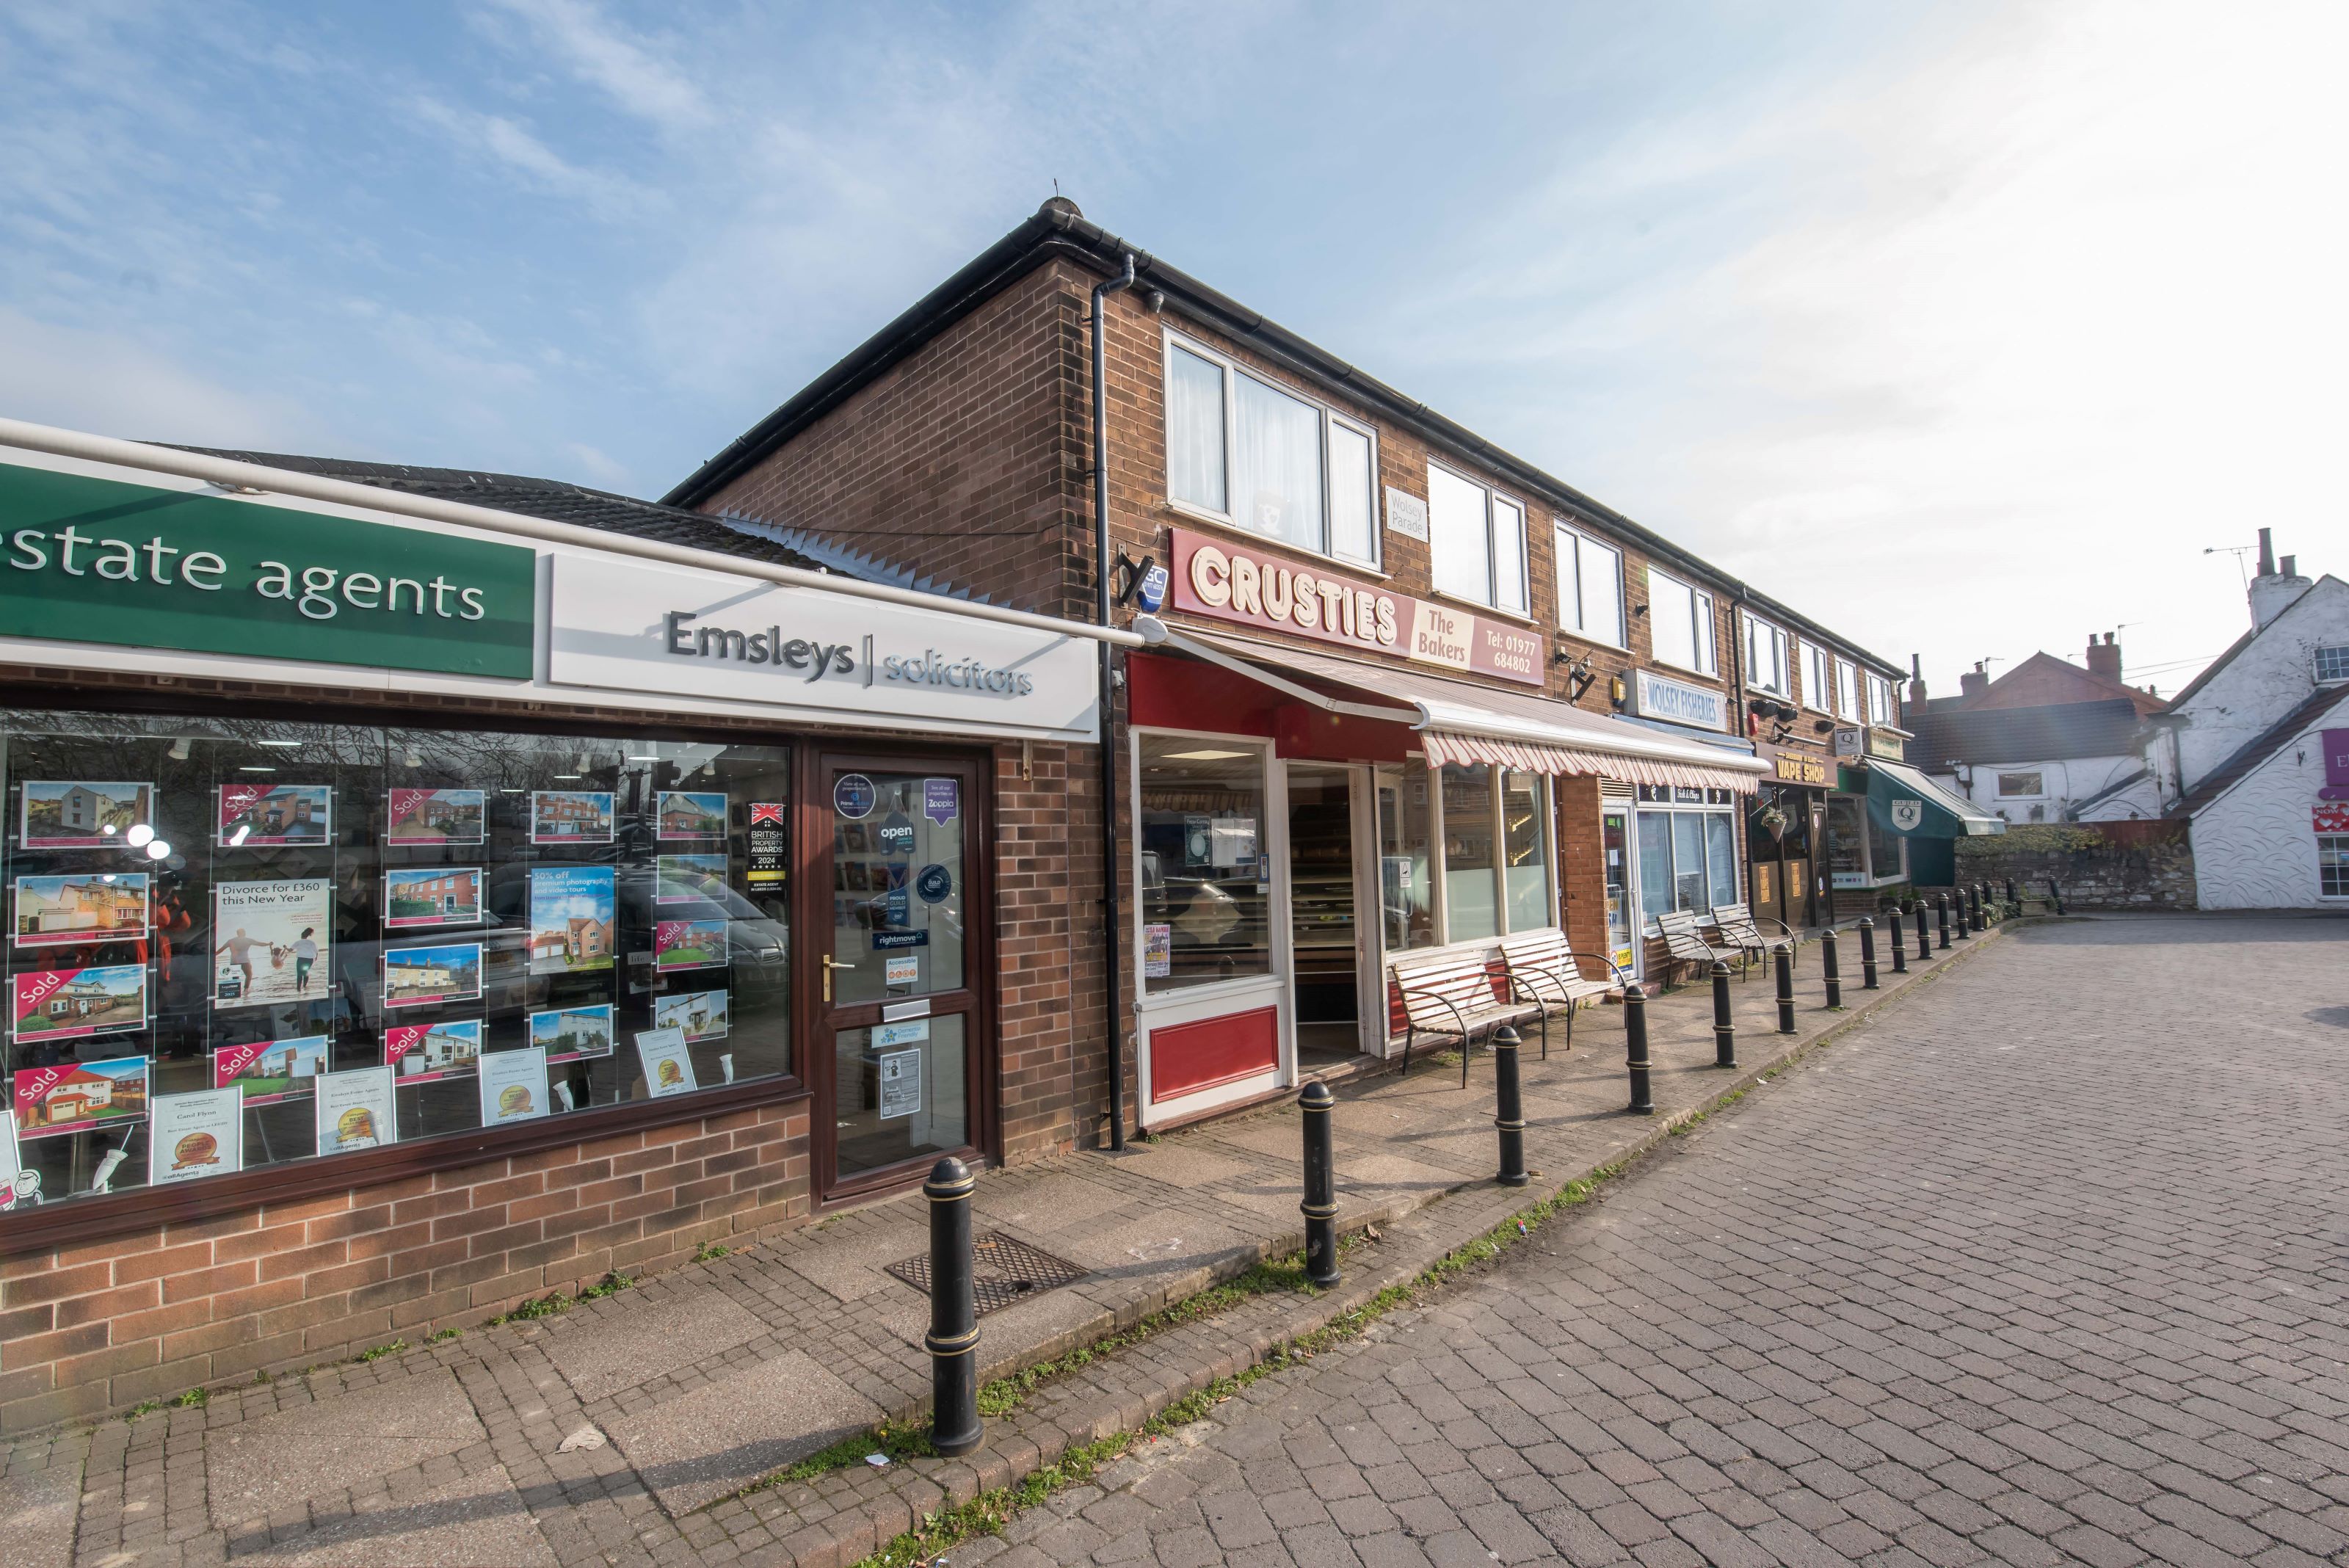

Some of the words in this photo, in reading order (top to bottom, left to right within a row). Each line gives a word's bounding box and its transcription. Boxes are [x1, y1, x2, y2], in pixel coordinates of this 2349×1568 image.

[1391, 495, 1422, 521] Wolsey
[1393, 511, 1423, 534] Parade
[0, 526, 227, 590] state
[256, 560, 484, 620] agents
[1191, 546, 1397, 645] CRUSTIES
[1428, 609, 1454, 636] The
[669, 611, 854, 683] Emsleys
[885, 647, 1034, 696] solicitors
[1418, 631, 1465, 662] Bakers
[1486, 630, 1503, 649] Tel:
[1506, 634, 1536, 656] 01977
[1494, 651, 1531, 674] 684802
[1647, 680, 1679, 716] WOLSEY
[1680, 689, 1716, 723] FISHERIES
[1777, 760, 1801, 780] VAPE
[1804, 763, 1825, 783] SHOP
[395, 789, 423, 814] Sold
[928, 799, 954, 808] Zoopla
[1677, 788, 1685, 799] Fish
[1689, 789, 1700, 802] Chips
[751, 830, 783, 838] BRITISH
[881, 827, 912, 840] open
[534, 872, 554, 880] 50%
[555, 871, 570, 879] off
[566, 877, 608, 886] photography
[222, 885, 269, 894] Divorce
[272, 883, 290, 893] for
[293, 882, 320, 892] £360
[222, 896, 244, 905] this
[248, 896, 276, 904] New
[279, 894, 305, 902] Year
[659, 922, 681, 945] Sold
[879, 936, 916, 945] rightmove
[21, 971, 60, 1003] Sold
[389, 1027, 419, 1054] Sold
[898, 1031, 918, 1039] Friendly
[220, 1045, 254, 1075] Sold
[19, 1067, 59, 1100] Sold
[333, 1143, 361, 1151] allAgents
[167, 1170, 200, 1180] allAgents
